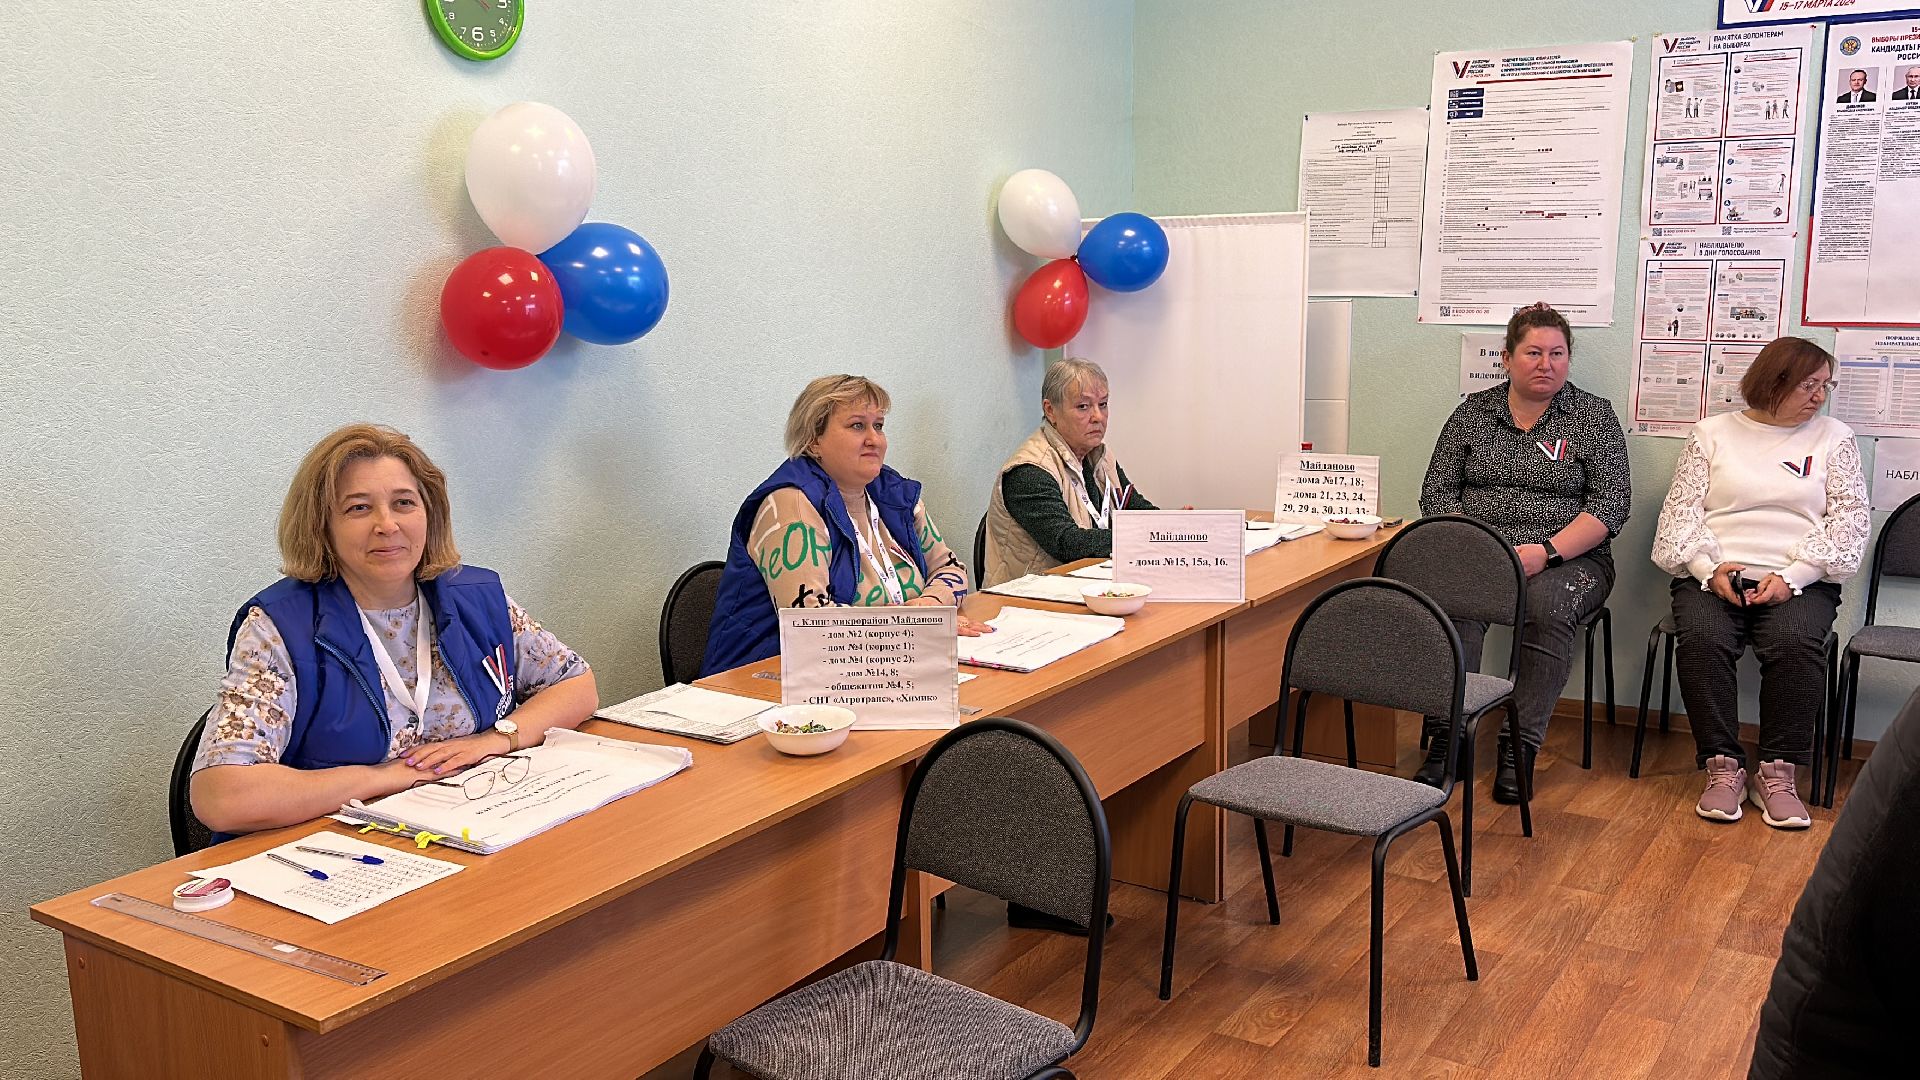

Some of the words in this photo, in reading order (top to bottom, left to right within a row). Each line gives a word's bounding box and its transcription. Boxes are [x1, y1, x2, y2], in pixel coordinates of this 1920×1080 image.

[1803, 0, 1832, 8] МАРТА
[471, 27, 484, 41] 6
[1714, 33, 1742, 42] ПАМЯТКА
[1872, 44, 1916, 53] КАНДИДАТЫ
[1300, 460, 1355, 470] Майданово
[1886, 470, 1919, 481] НАБЛ
[1322, 476, 1347, 486] №17,
[1350, 477, 1364, 488] 18;
[1320, 491, 1333, 500] 21,
[1336, 492, 1349, 501] 23,
[1352, 492, 1366, 502] 24,
[1283, 504, 1295, 513] 29,
[1298, 504, 1309, 513] 29
[1322, 506, 1336, 514] 30,
[1149, 531, 1208, 541] Майданово
[1162, 558, 1189, 568] №15,
[1192, 558, 1211, 567] 15а,
[1214, 558, 1228, 566] 16.
[832, 617, 889, 626] микрорайон
[891, 616, 943, 624] Майданово
[864, 630, 898, 639] (корпус
[900, 629, 914, 637] 4);
[865, 643, 900, 652] (корпус
[902, 642, 915, 650] 1);
[865, 656, 901, 665] (корпус
[902, 654, 915, 663] 2);
[865, 669, 889, 677] №14,
[890, 668, 899, 677] 8;
[831, 682, 884, 691] общежития
[885, 681, 904, 690] №4,
[906, 681, 914, 689] 5;
[808, 696, 830, 704] СНТ
[833, 695, 894, 705] «Агротранс»,
[896, 694, 938, 702] «Химик»
